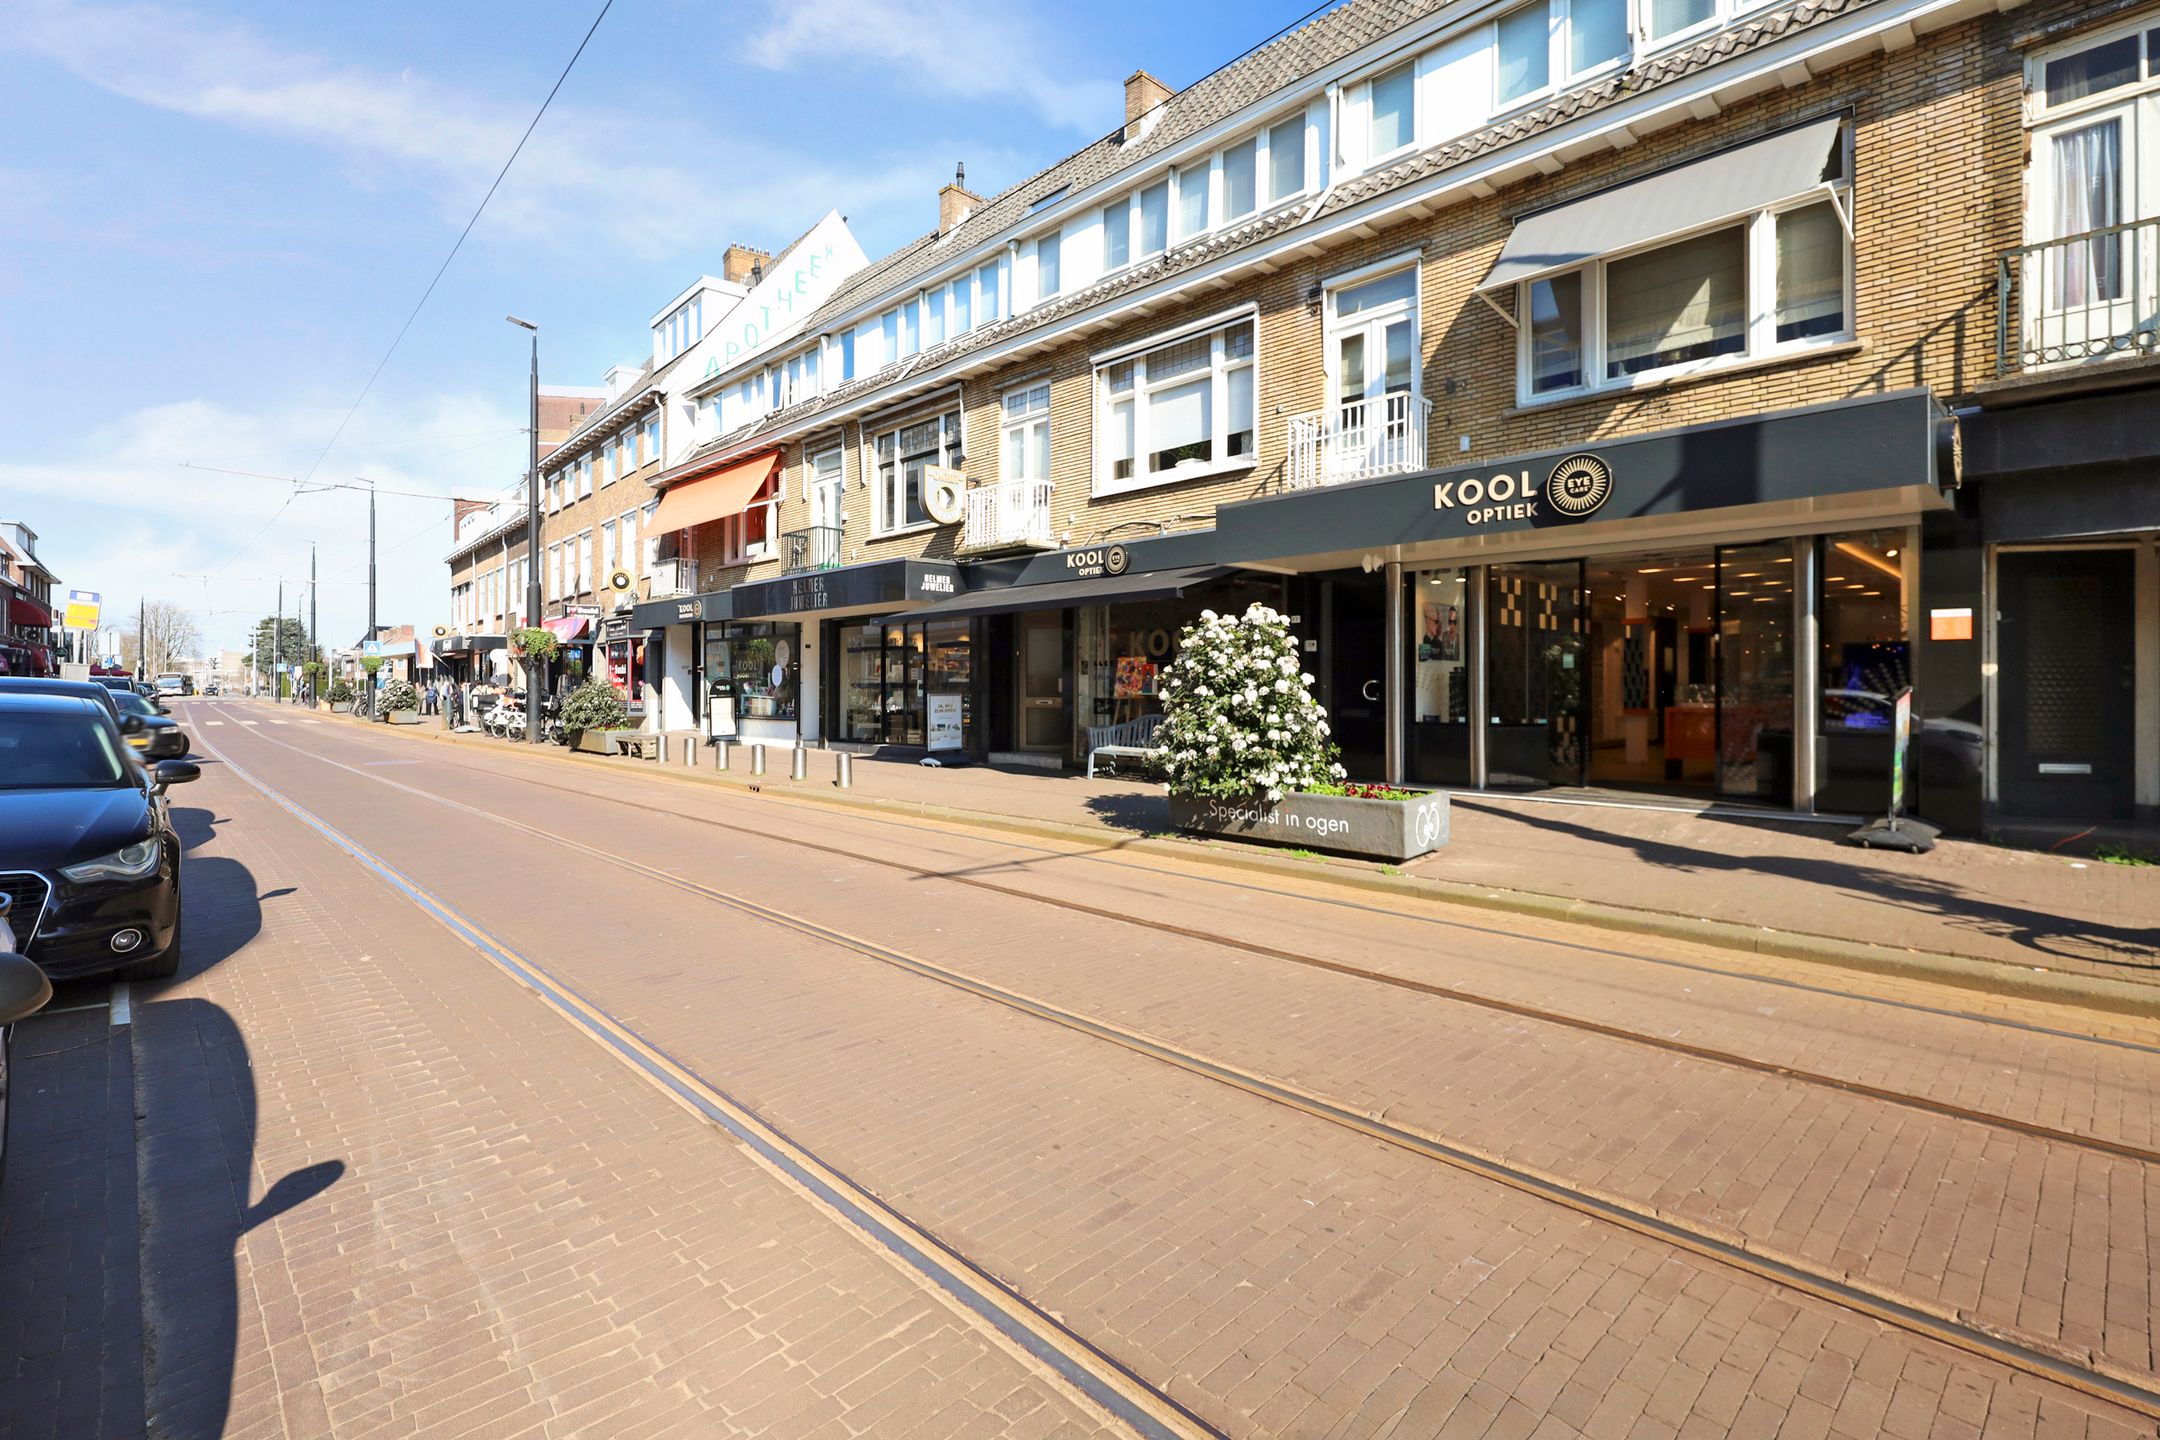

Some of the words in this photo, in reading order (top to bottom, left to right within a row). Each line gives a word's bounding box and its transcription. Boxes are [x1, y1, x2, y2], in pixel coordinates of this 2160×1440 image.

[1433, 470, 1537, 510] KOOL
[1567, 476, 1591, 487] EYE
[1466, 502, 1538, 525] OPTIEK
[1066, 550, 1104, 568] KOOL
[924, 573, 951, 584] HELMER
[1078, 566, 1104, 576] OPTIEK
[792, 577, 825, 595] HELMER
[920, 582, 954, 593] JUWELIER
[790, 592, 828, 610] JUWELIER
[1209, 799, 1280, 824] Specialist
[1285, 811, 1300, 828] in
[1306, 816, 1349, 836] ogen
